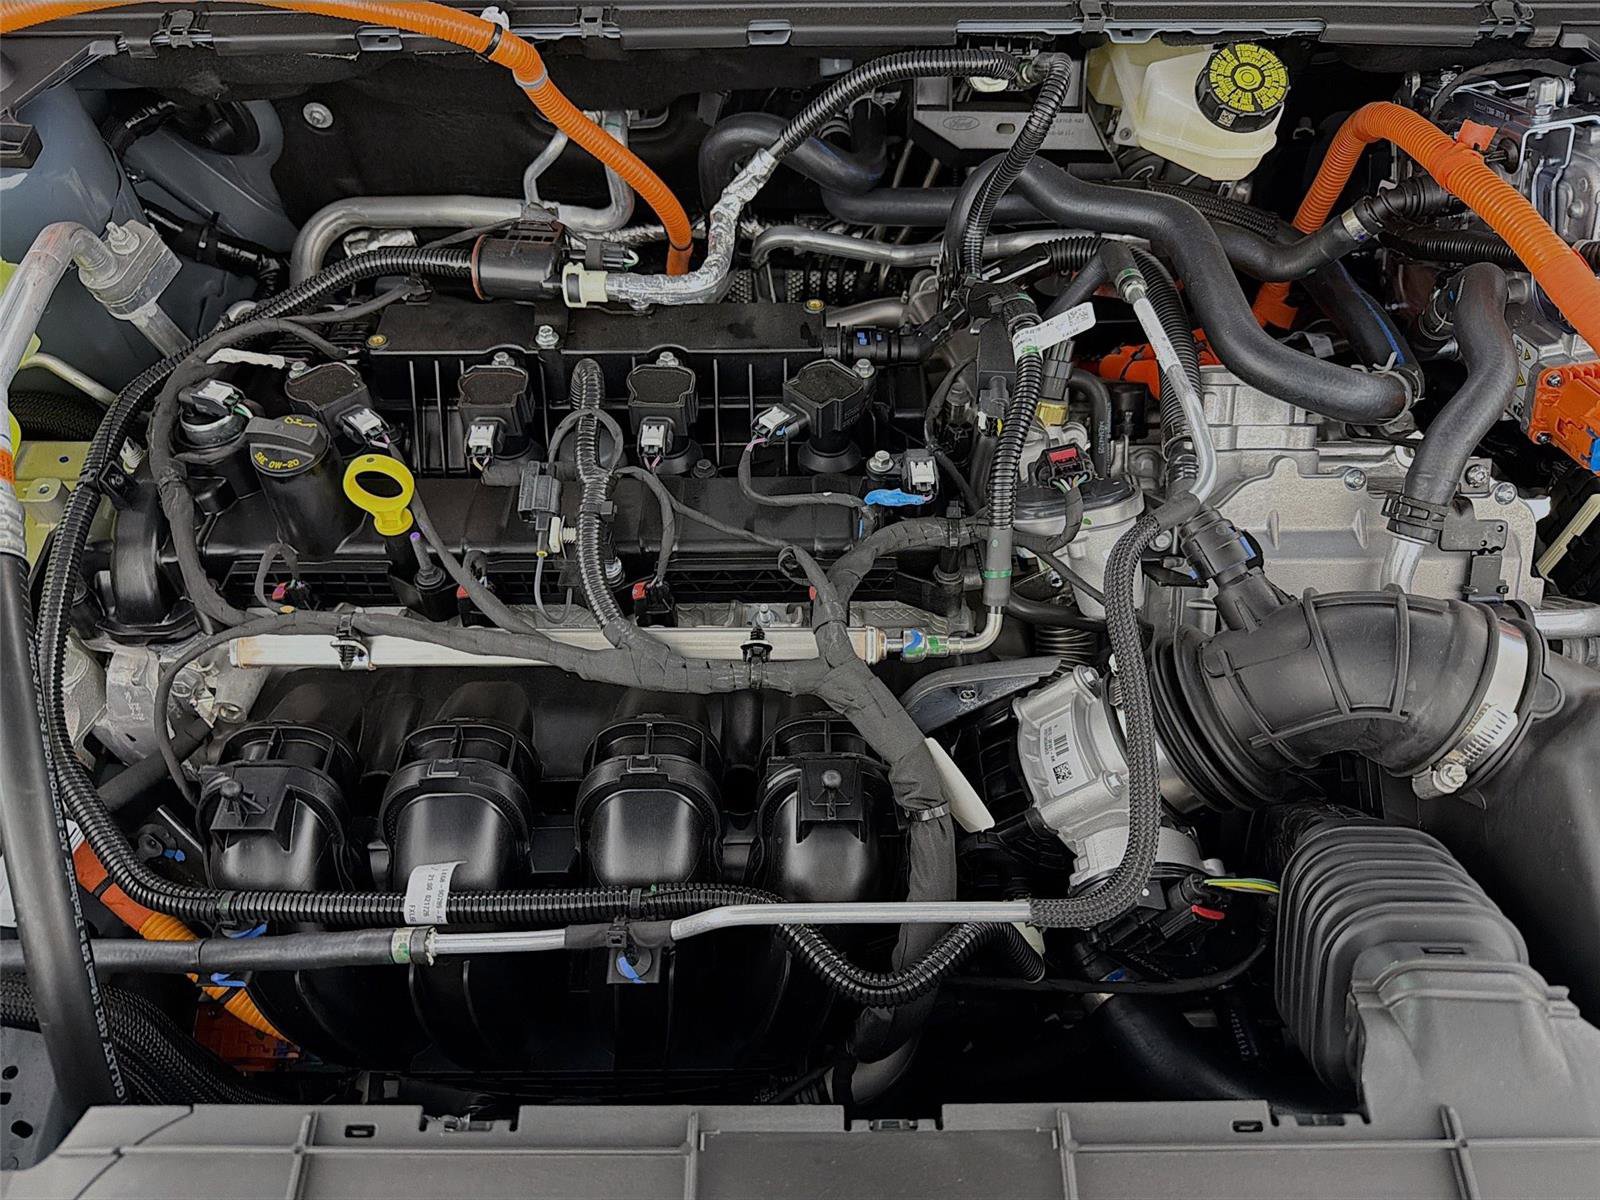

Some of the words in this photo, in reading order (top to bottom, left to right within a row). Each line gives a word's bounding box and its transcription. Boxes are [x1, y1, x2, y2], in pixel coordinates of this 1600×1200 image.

[946, 116, 977, 130] Ford
[254, 451, 269, 466] SAE
[42, 734, 54, 769] HOSE
[48, 771, 64, 828] SUCTION
[65, 857, 84, 929] Flexbarrier
[95, 1006, 108, 1038] 4882
[103, 1041, 125, 1098] GALAXY
